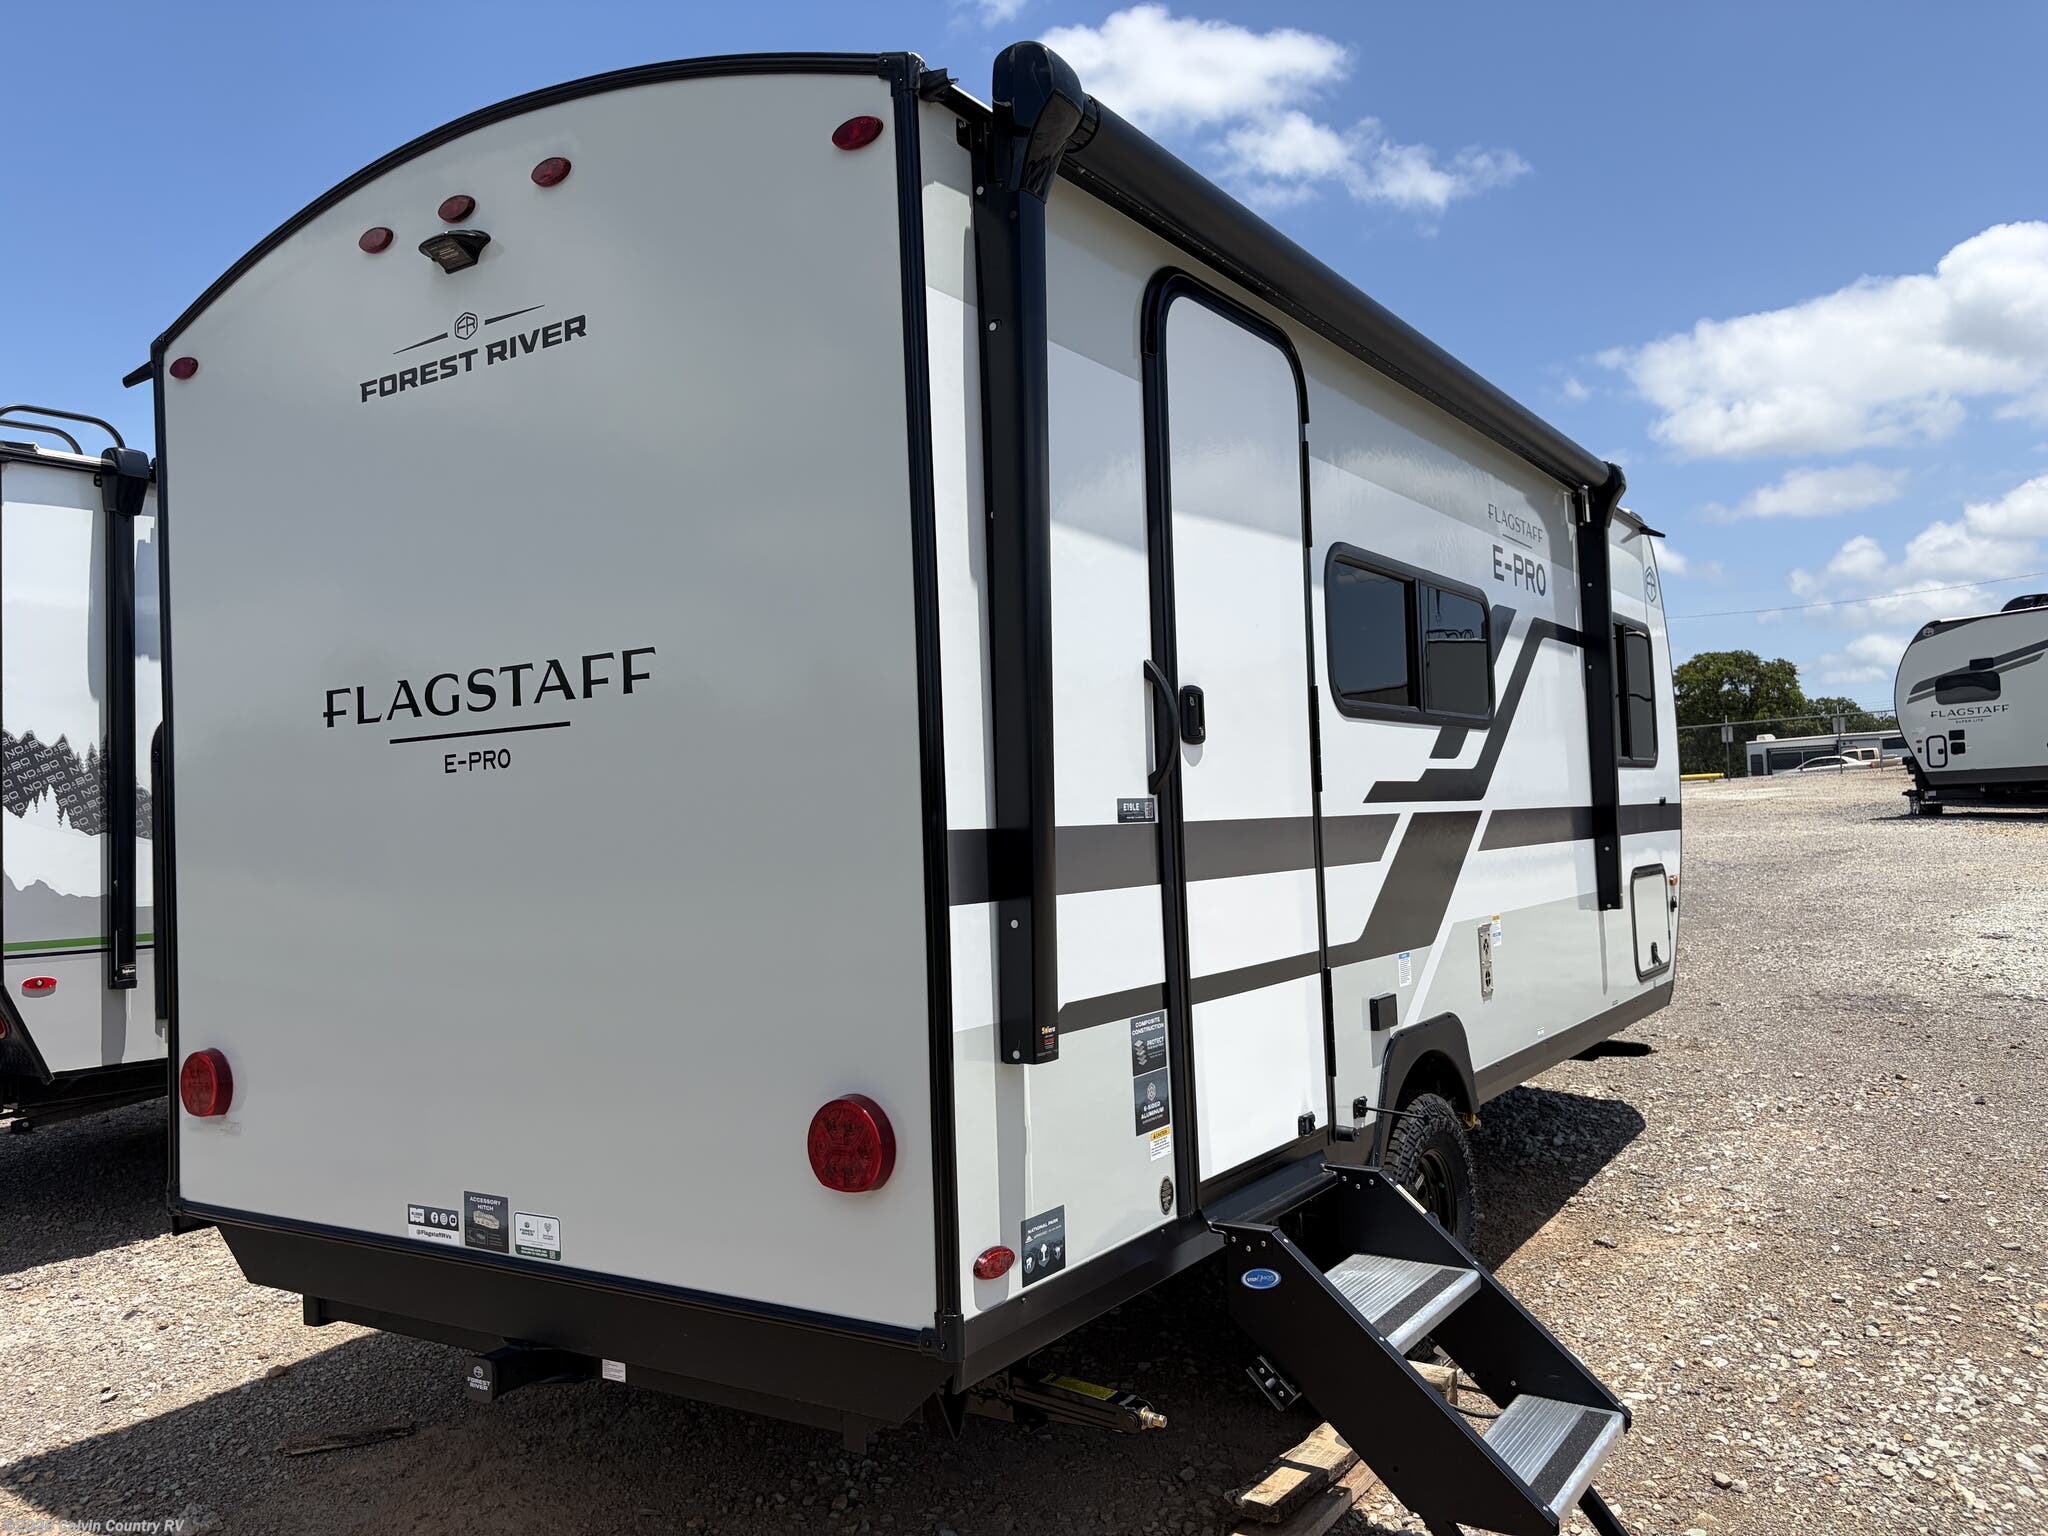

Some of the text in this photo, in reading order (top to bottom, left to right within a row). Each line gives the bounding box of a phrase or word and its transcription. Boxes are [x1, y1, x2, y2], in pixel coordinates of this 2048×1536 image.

[360, 315, 587, 403] FOREST RIVER
[1488, 503, 1543, 543] FLAGSTAFF
[1493, 544, 1546, 596] E-PRO
[323, 647, 656, 728] FLAGSTAFF
[1930, 703, 2009, 718] FLAGSTAFF
[444, 748, 511, 774] E-PRO
[1132, 1023, 1164, 1036] CONSTRUCTION
[1141, 1106, 1164, 1120] ALUMINUM
[469, 1196, 502, 1206] ACCESSORY
[477, 1204, 494, 1212] HITCH
[416, 1229, 452, 1240] @FlagstaffRVs
[1028, 1223, 1047, 1234] NATIONAL
[467, 1376, 491, 1386] FOREST
[470, 1382, 489, 1391] RIVER
